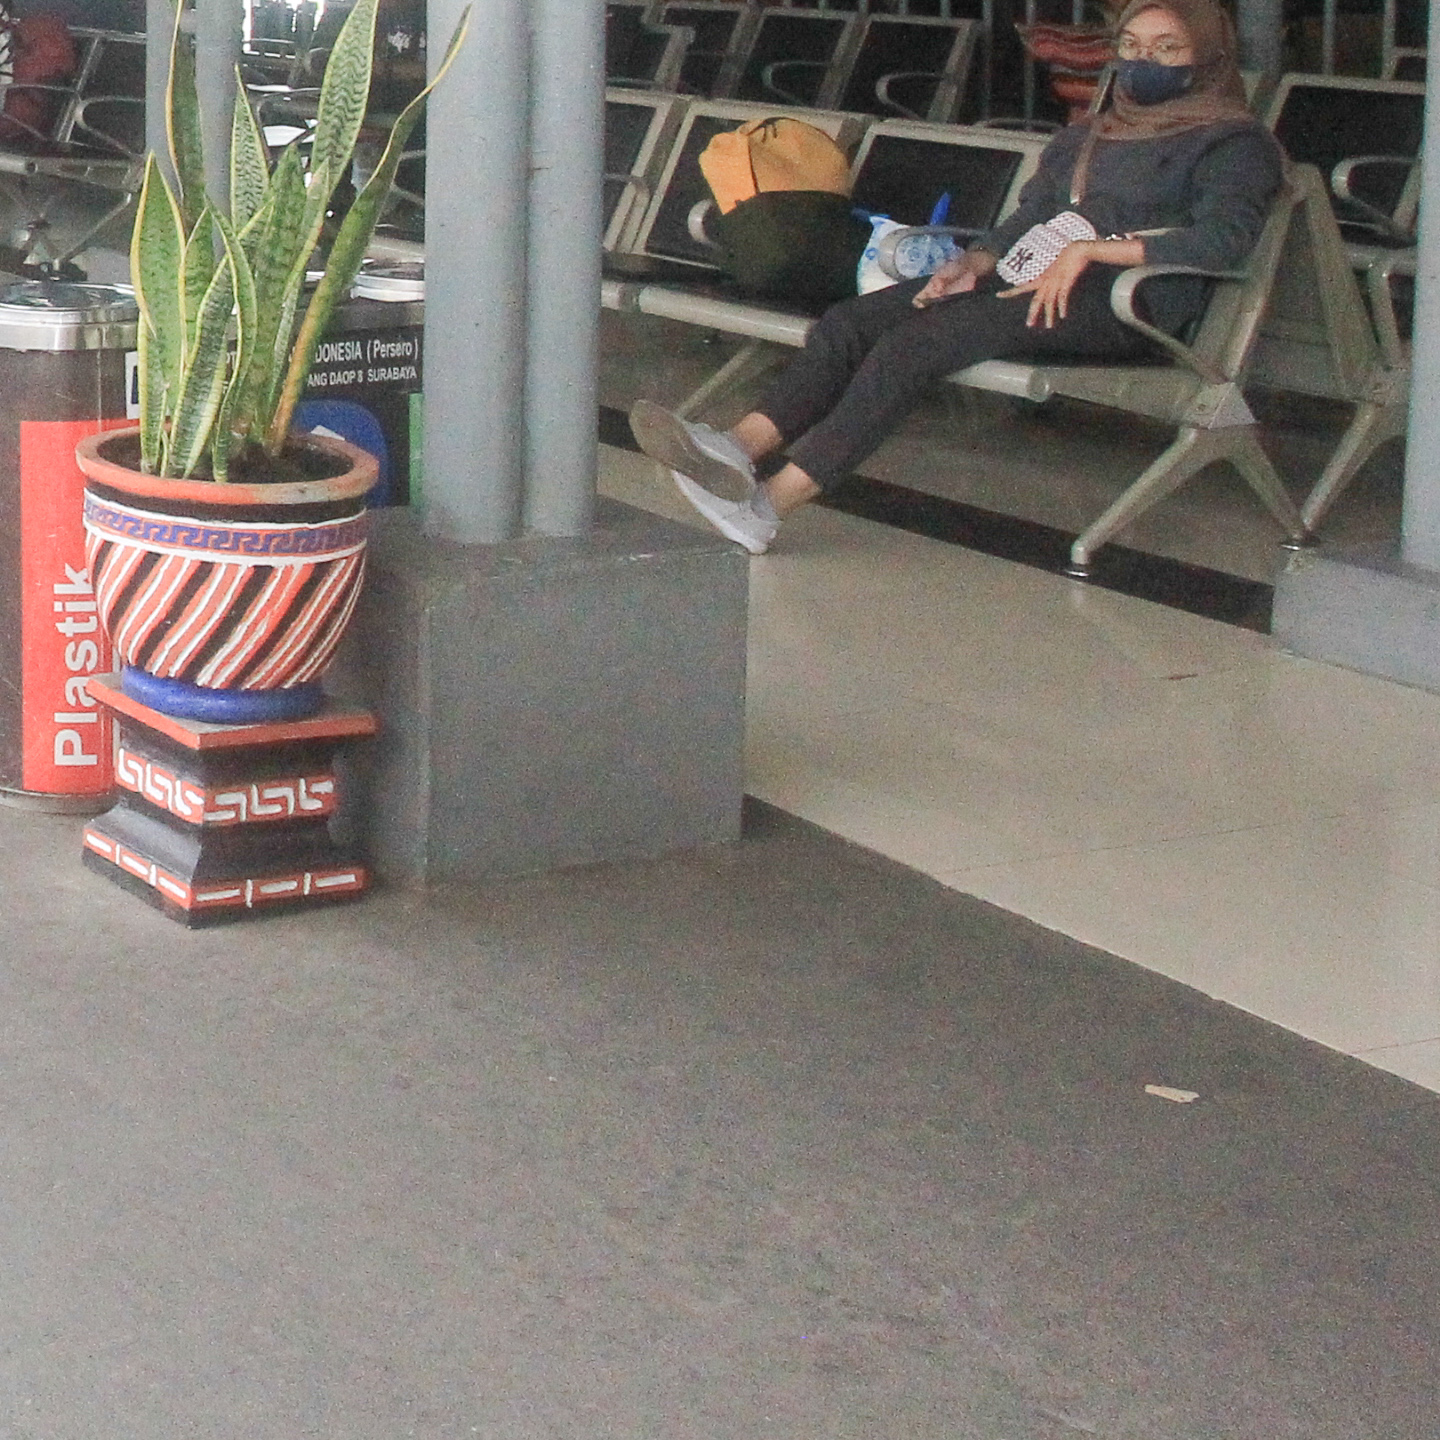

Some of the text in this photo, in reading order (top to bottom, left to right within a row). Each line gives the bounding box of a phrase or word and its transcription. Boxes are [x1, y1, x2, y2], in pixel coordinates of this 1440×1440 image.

[315, 340, 362, 363] DONESIA
[329, 370, 356, 386] DAOP
[367, 366, 418, 383] SURABAYA
[53, 562, 99, 766] Plastik
